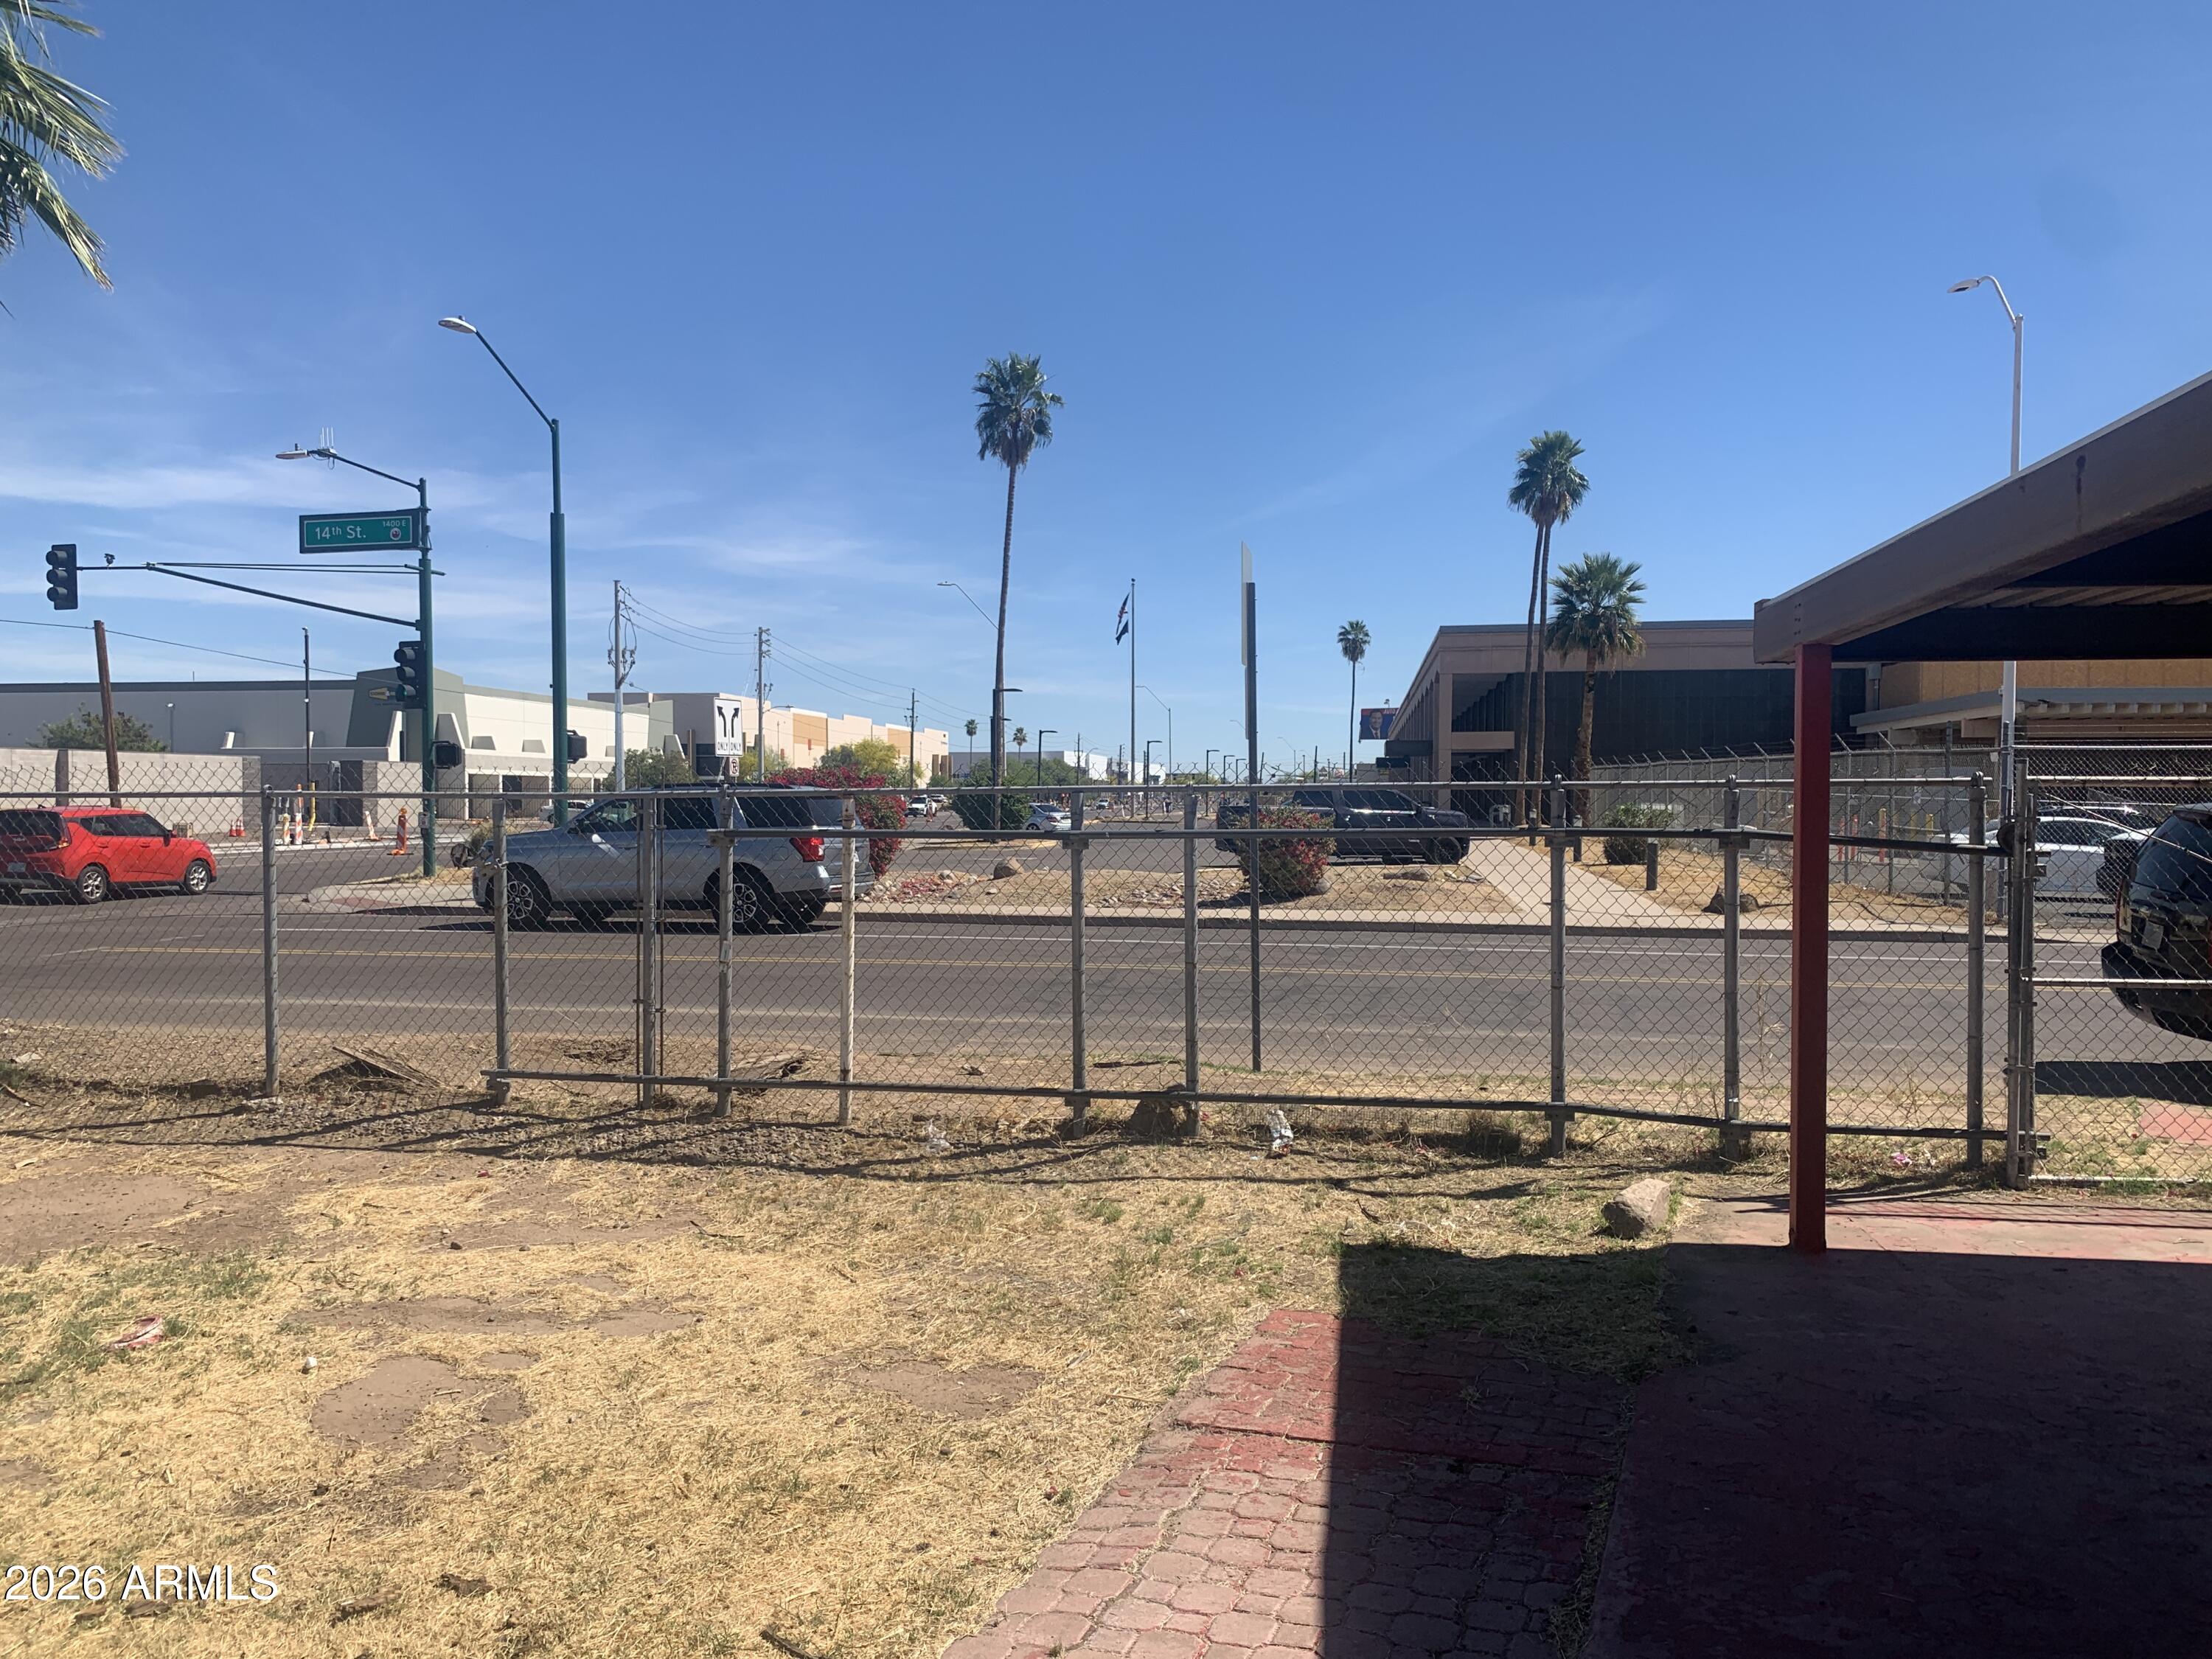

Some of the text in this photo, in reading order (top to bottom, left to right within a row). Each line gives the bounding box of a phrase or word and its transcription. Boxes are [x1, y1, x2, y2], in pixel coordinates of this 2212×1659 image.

[315, 525, 366, 540] 14th St.
[717, 741, 728, 751] ONLY
[730, 741, 742, 751] ONLY
